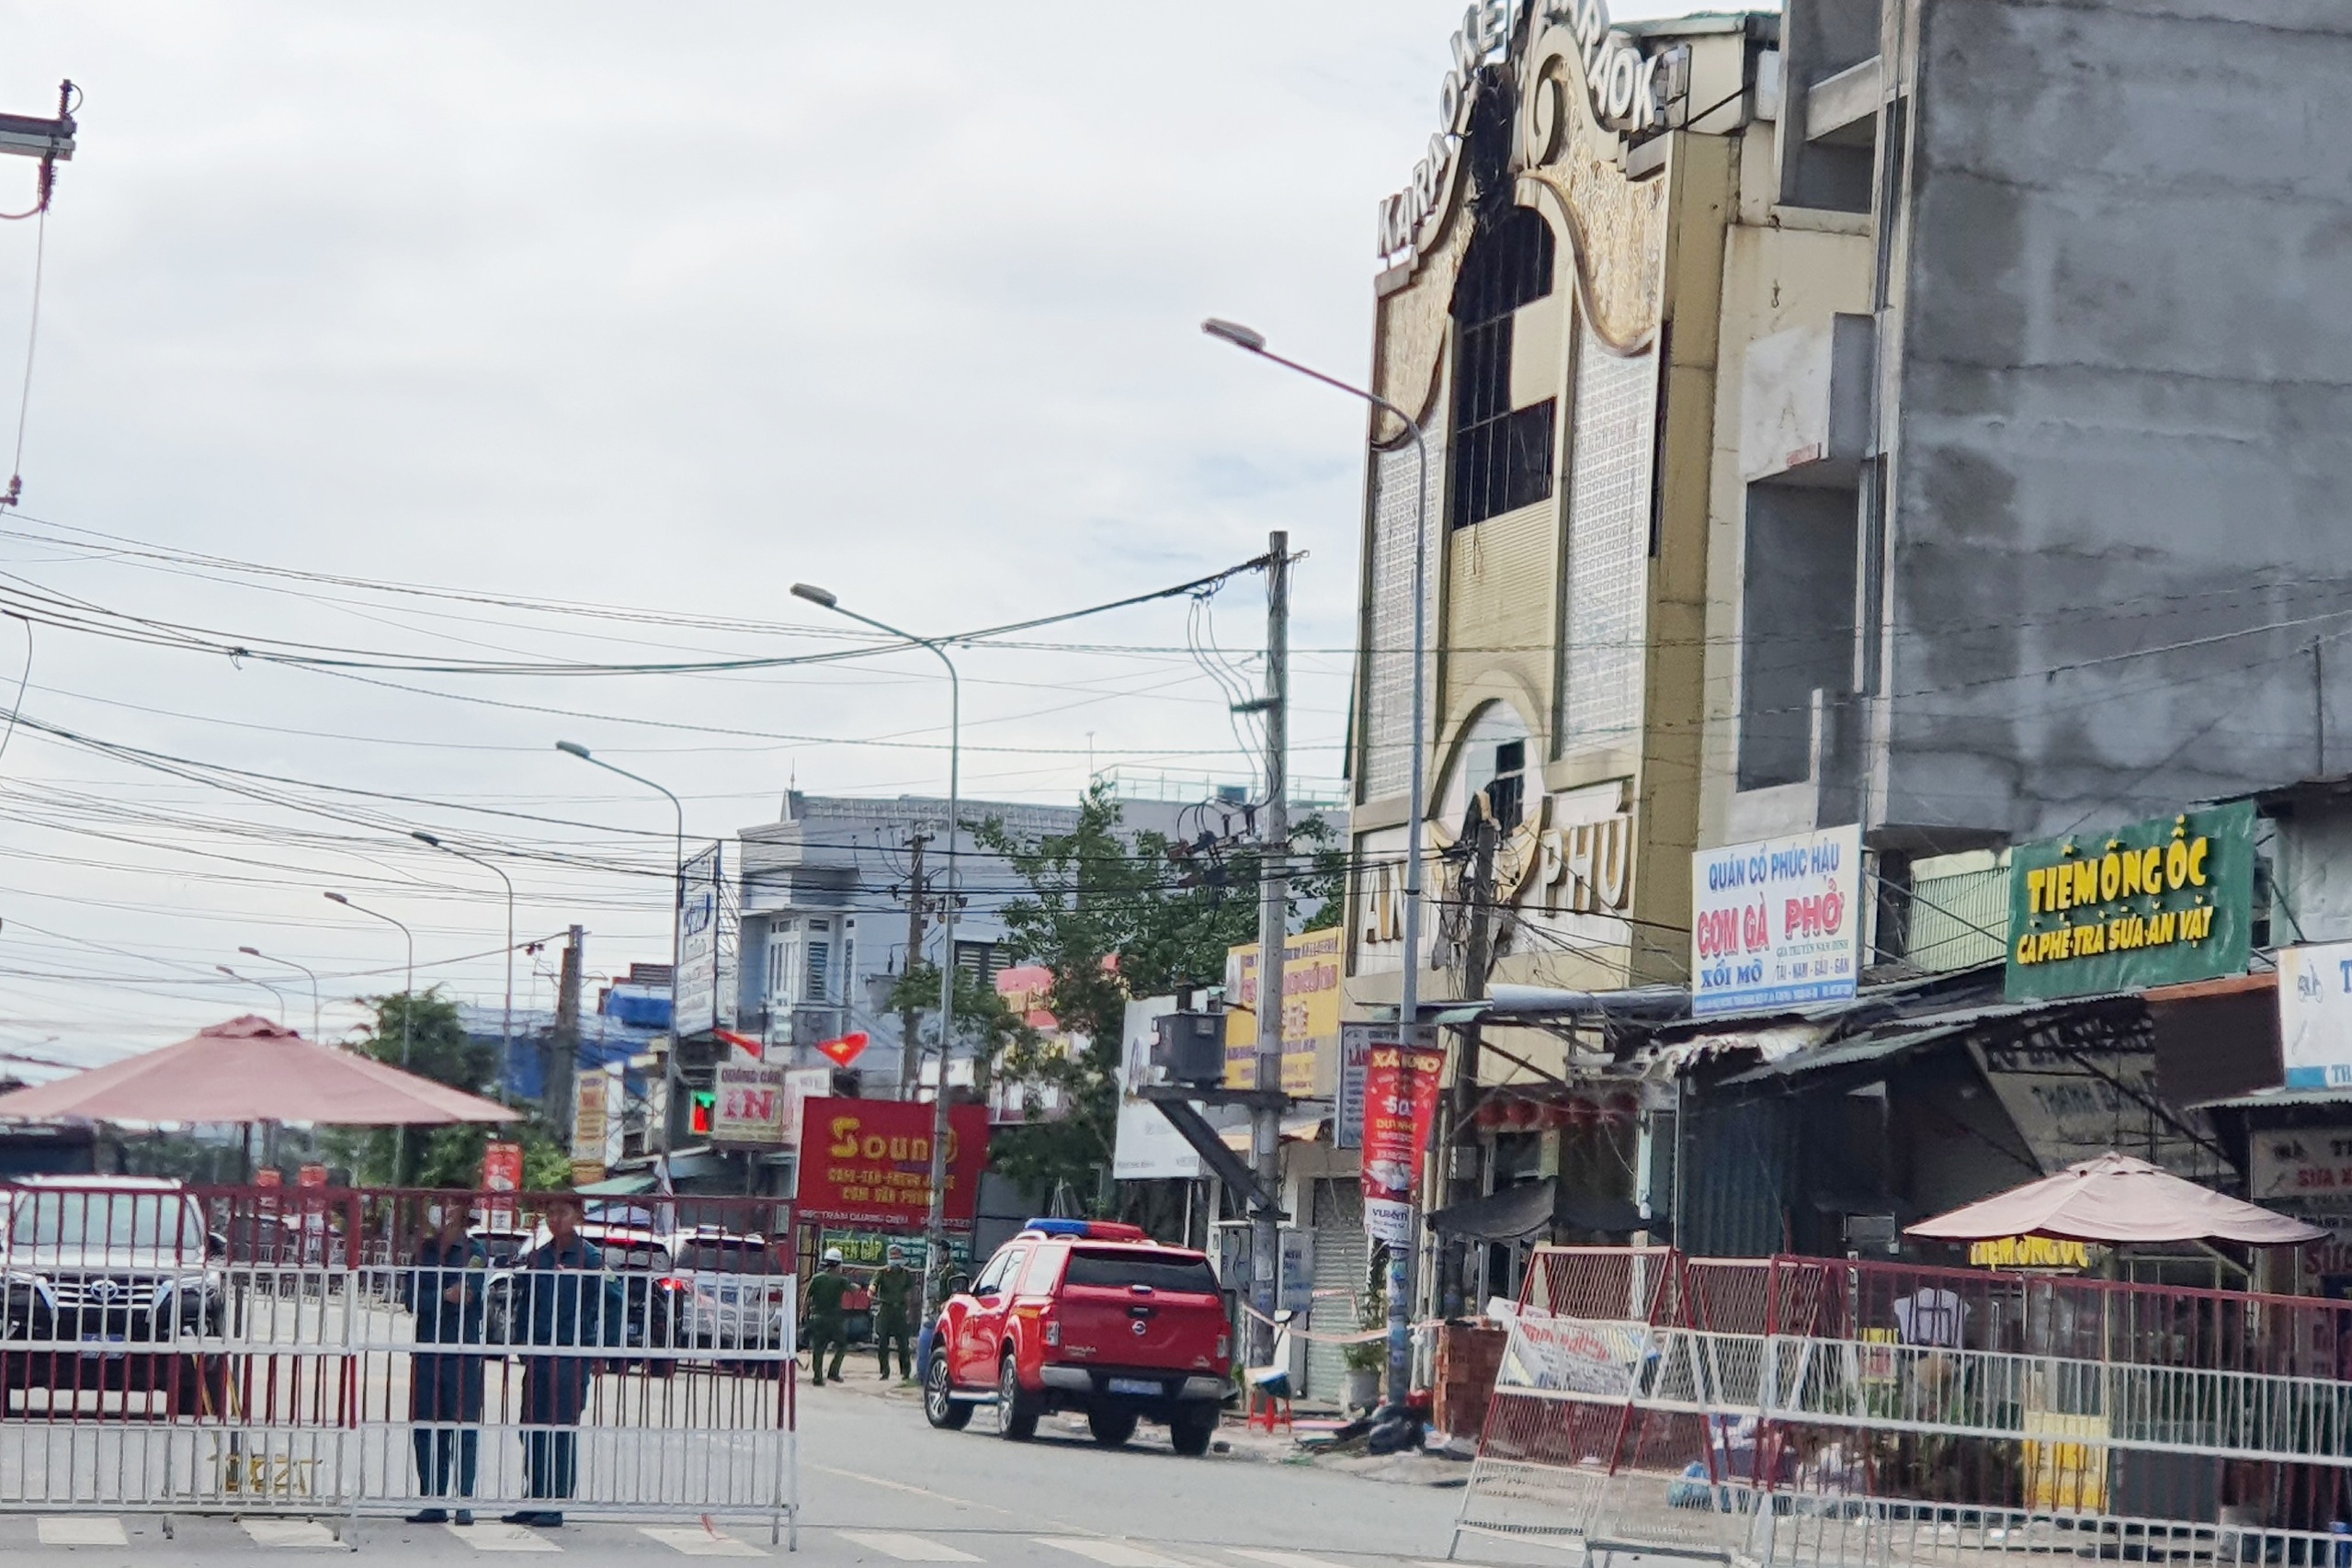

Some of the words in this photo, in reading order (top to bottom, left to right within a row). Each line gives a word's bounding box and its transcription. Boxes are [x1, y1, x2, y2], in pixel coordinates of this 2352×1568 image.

[1709, 853, 1745, 891] QUÁN
[1771, 842, 1808, 881] PHÚC
[1812, 837, 1841, 881] HẬU
[1744, 891, 1770, 954] GÀ
[1785, 878, 1845, 940] PHỞ
[1700, 959, 1731, 988] XỐI
[723, 1088, 775, 1120] IN
